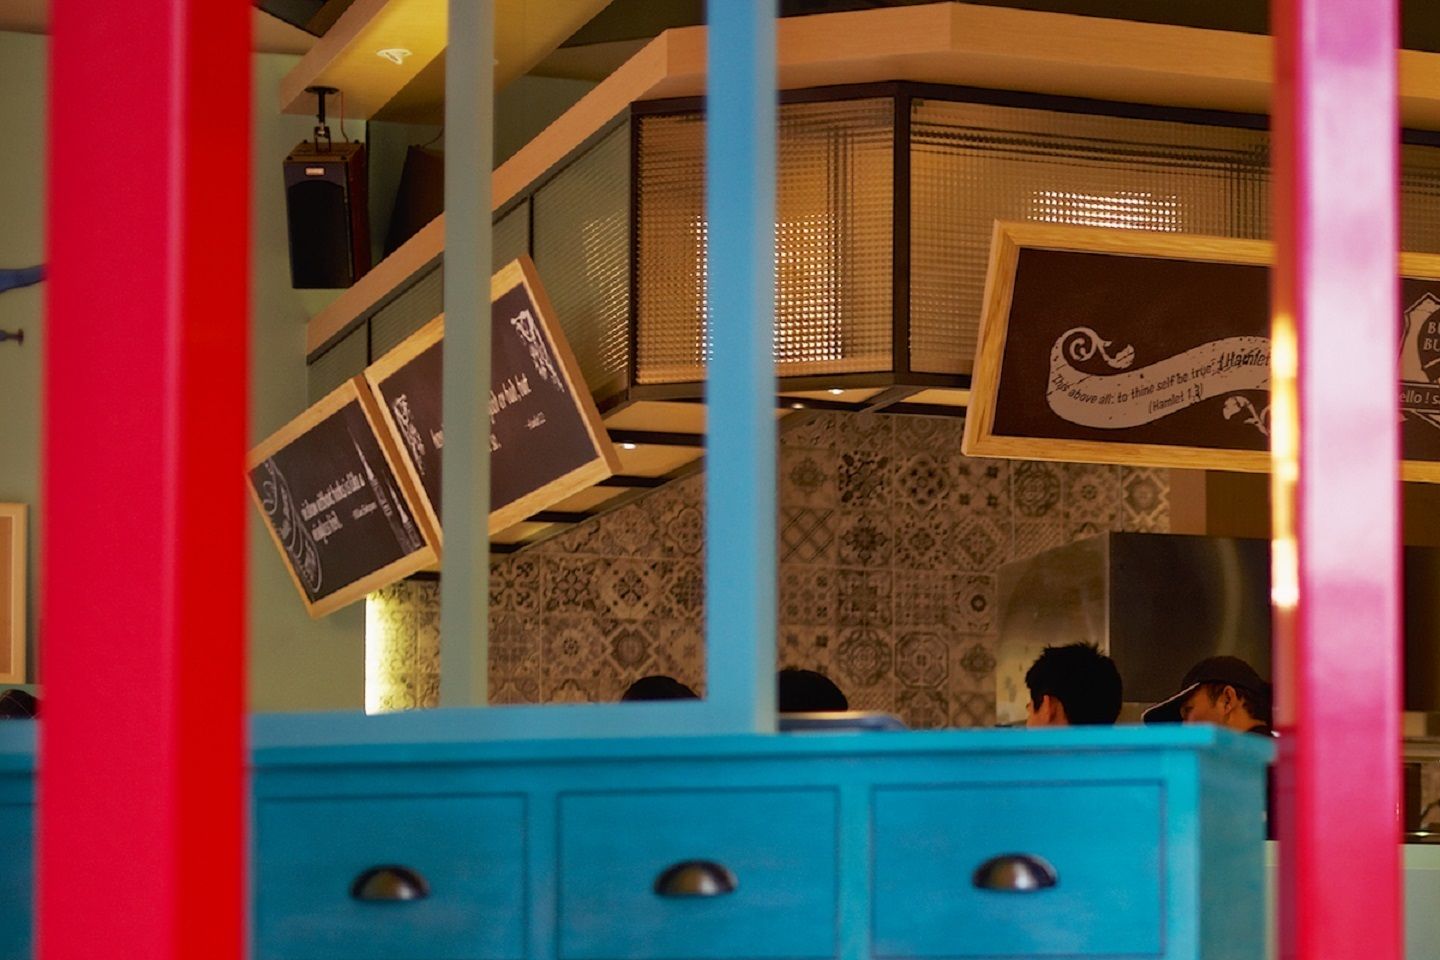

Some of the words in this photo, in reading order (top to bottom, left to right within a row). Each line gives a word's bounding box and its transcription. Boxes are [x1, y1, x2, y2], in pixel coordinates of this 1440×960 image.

[1068, 388, 1098, 404] above
[1117, 391, 1128, 403] to
[1131, 384, 1154, 400] thine
[1157, 375, 1175, 391] self
[1176, 372, 1189, 384] be
[1149, 389, 1185, 414] (Hamlet
